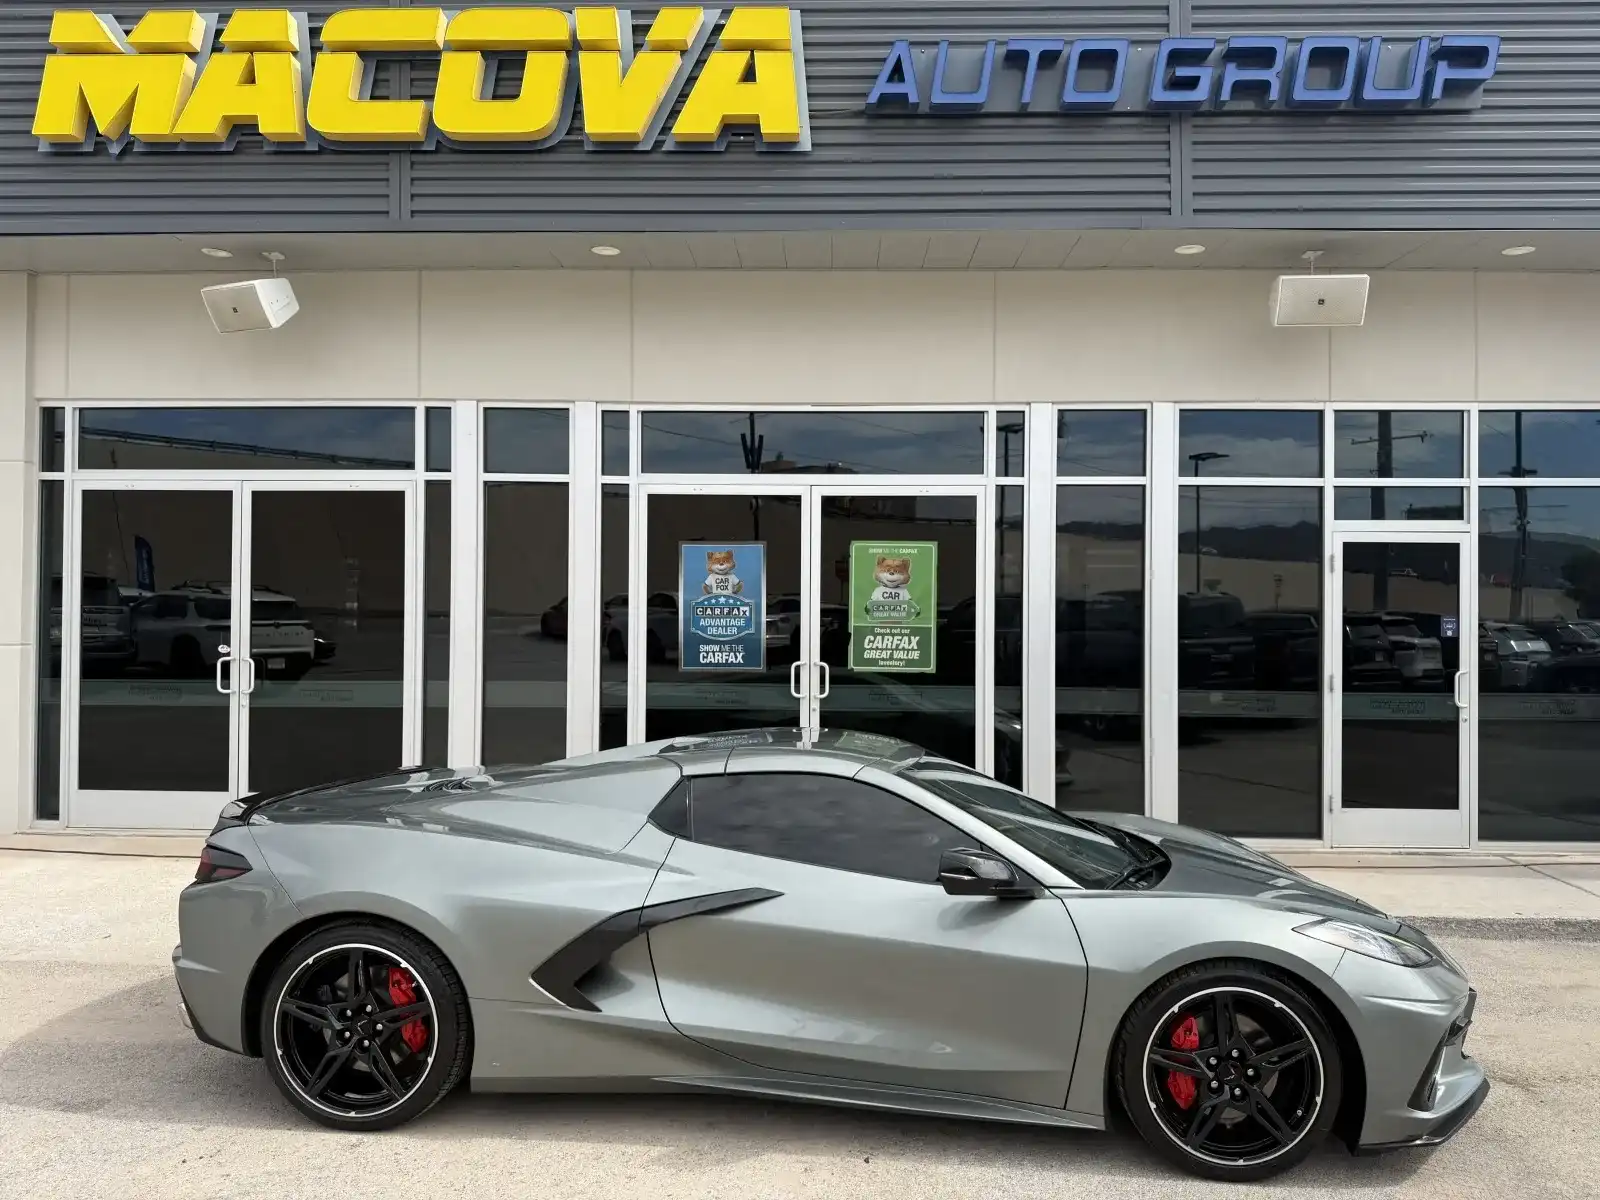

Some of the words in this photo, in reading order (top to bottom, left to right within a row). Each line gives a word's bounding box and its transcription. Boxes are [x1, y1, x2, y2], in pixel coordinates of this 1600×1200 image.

[32, 6, 803, 144] MACOVA
[866, 38, 1131, 108] AUTO
[1150, 34, 1501, 109] GROUP
[715, 577, 730, 585] CAR
[881, 591, 900, 600] CAR
[696, 607, 749, 617] CARFAX
[873, 604, 908, 612] CARFAX
[699, 618, 746, 626] ADVANTAGE
[707, 626, 738, 635] DEALER
[863, 635, 920, 649] CARFAX
[699, 644, 720, 652] SHOW
[720, 644, 731, 652] ME
[731, 644, 744, 652] THE
[699, 652, 745, 664] CARFAX
[863, 649, 893, 659] GREAT
[893, 650, 921, 660] VALUE
